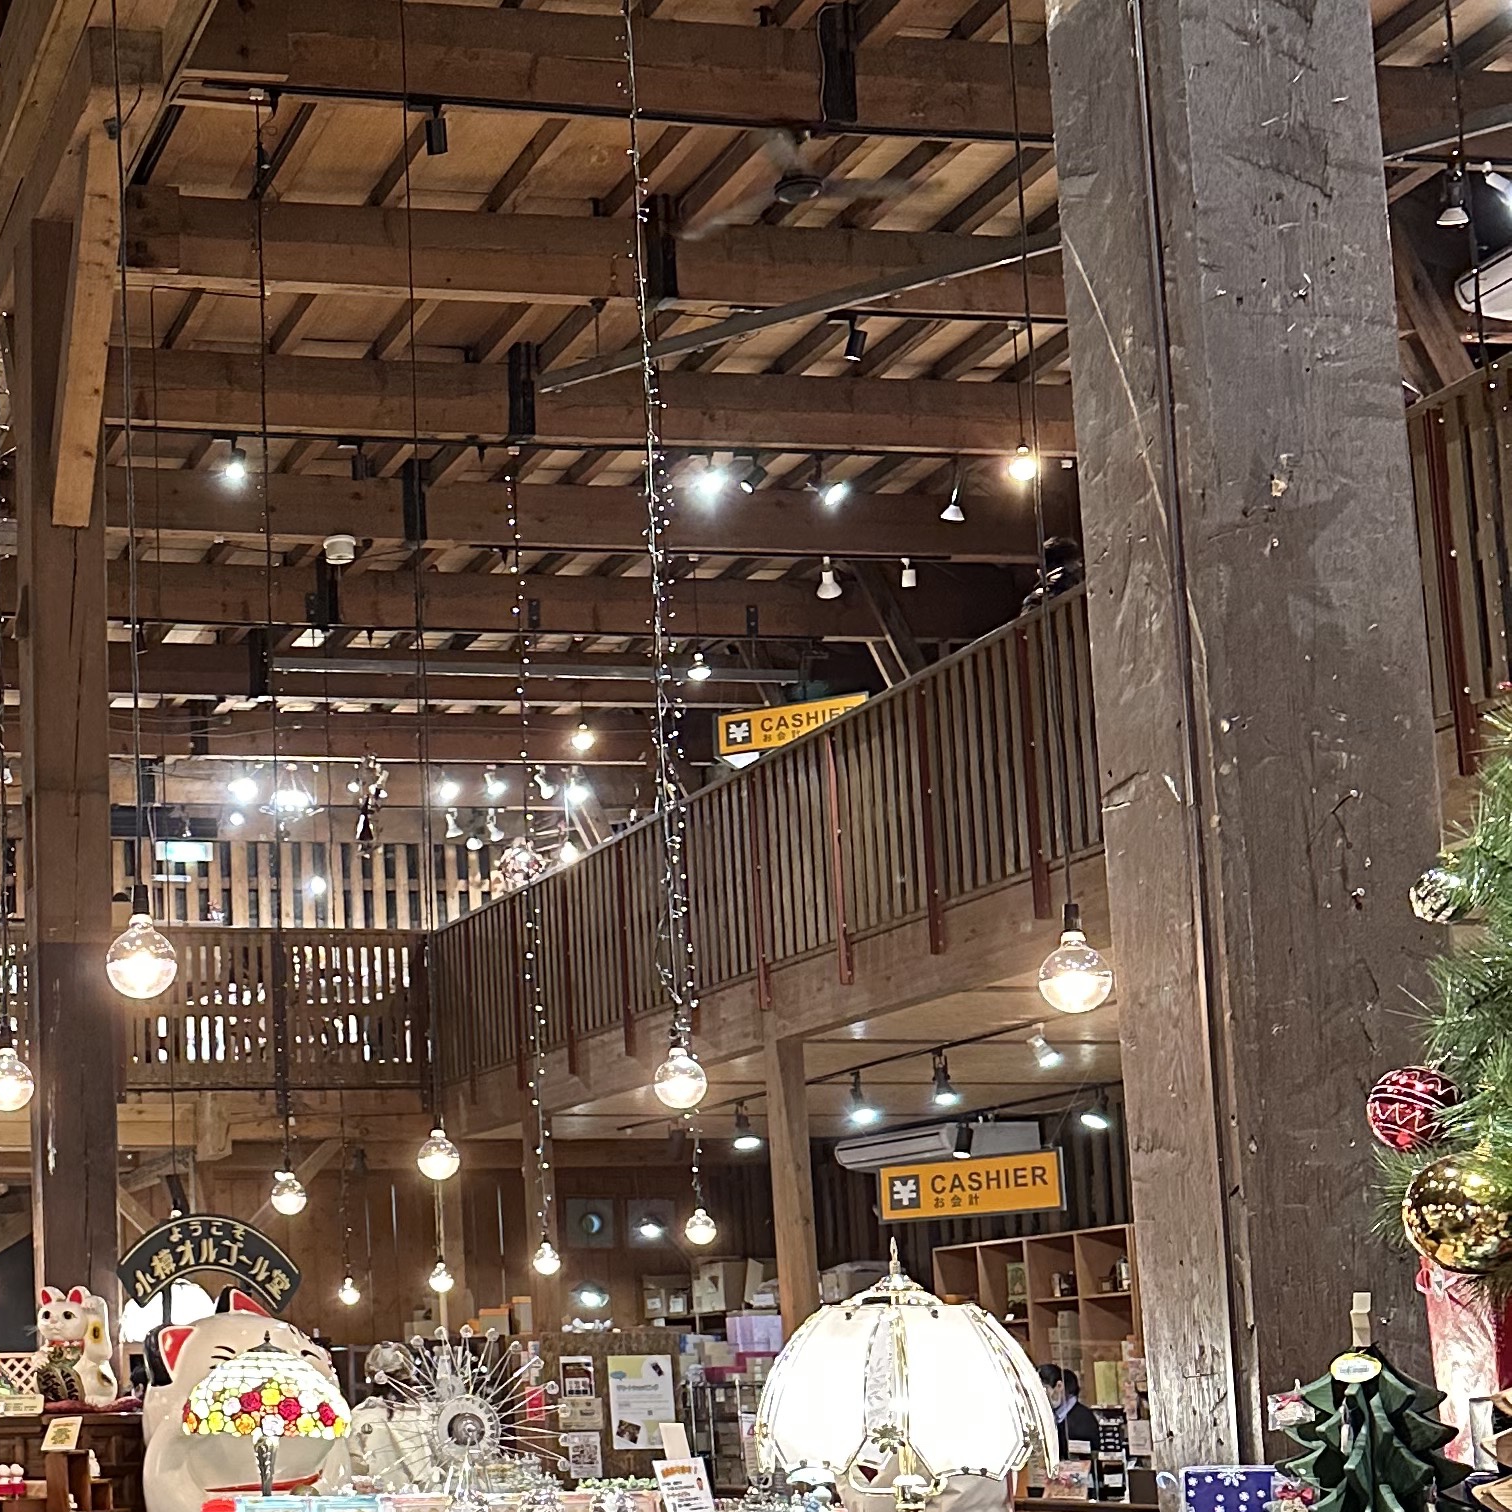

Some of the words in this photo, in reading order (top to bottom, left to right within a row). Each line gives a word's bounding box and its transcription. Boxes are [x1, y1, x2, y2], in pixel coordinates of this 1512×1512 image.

[760, 705, 854, 732] CASHIE
[930, 1165, 1049, 1195] CASHIER
[933, 1193, 980, 1208] お会計
[169, 1221, 246, 1243] ようこそ
[135, 1237, 291, 1301] 小樽オルゴール堂
